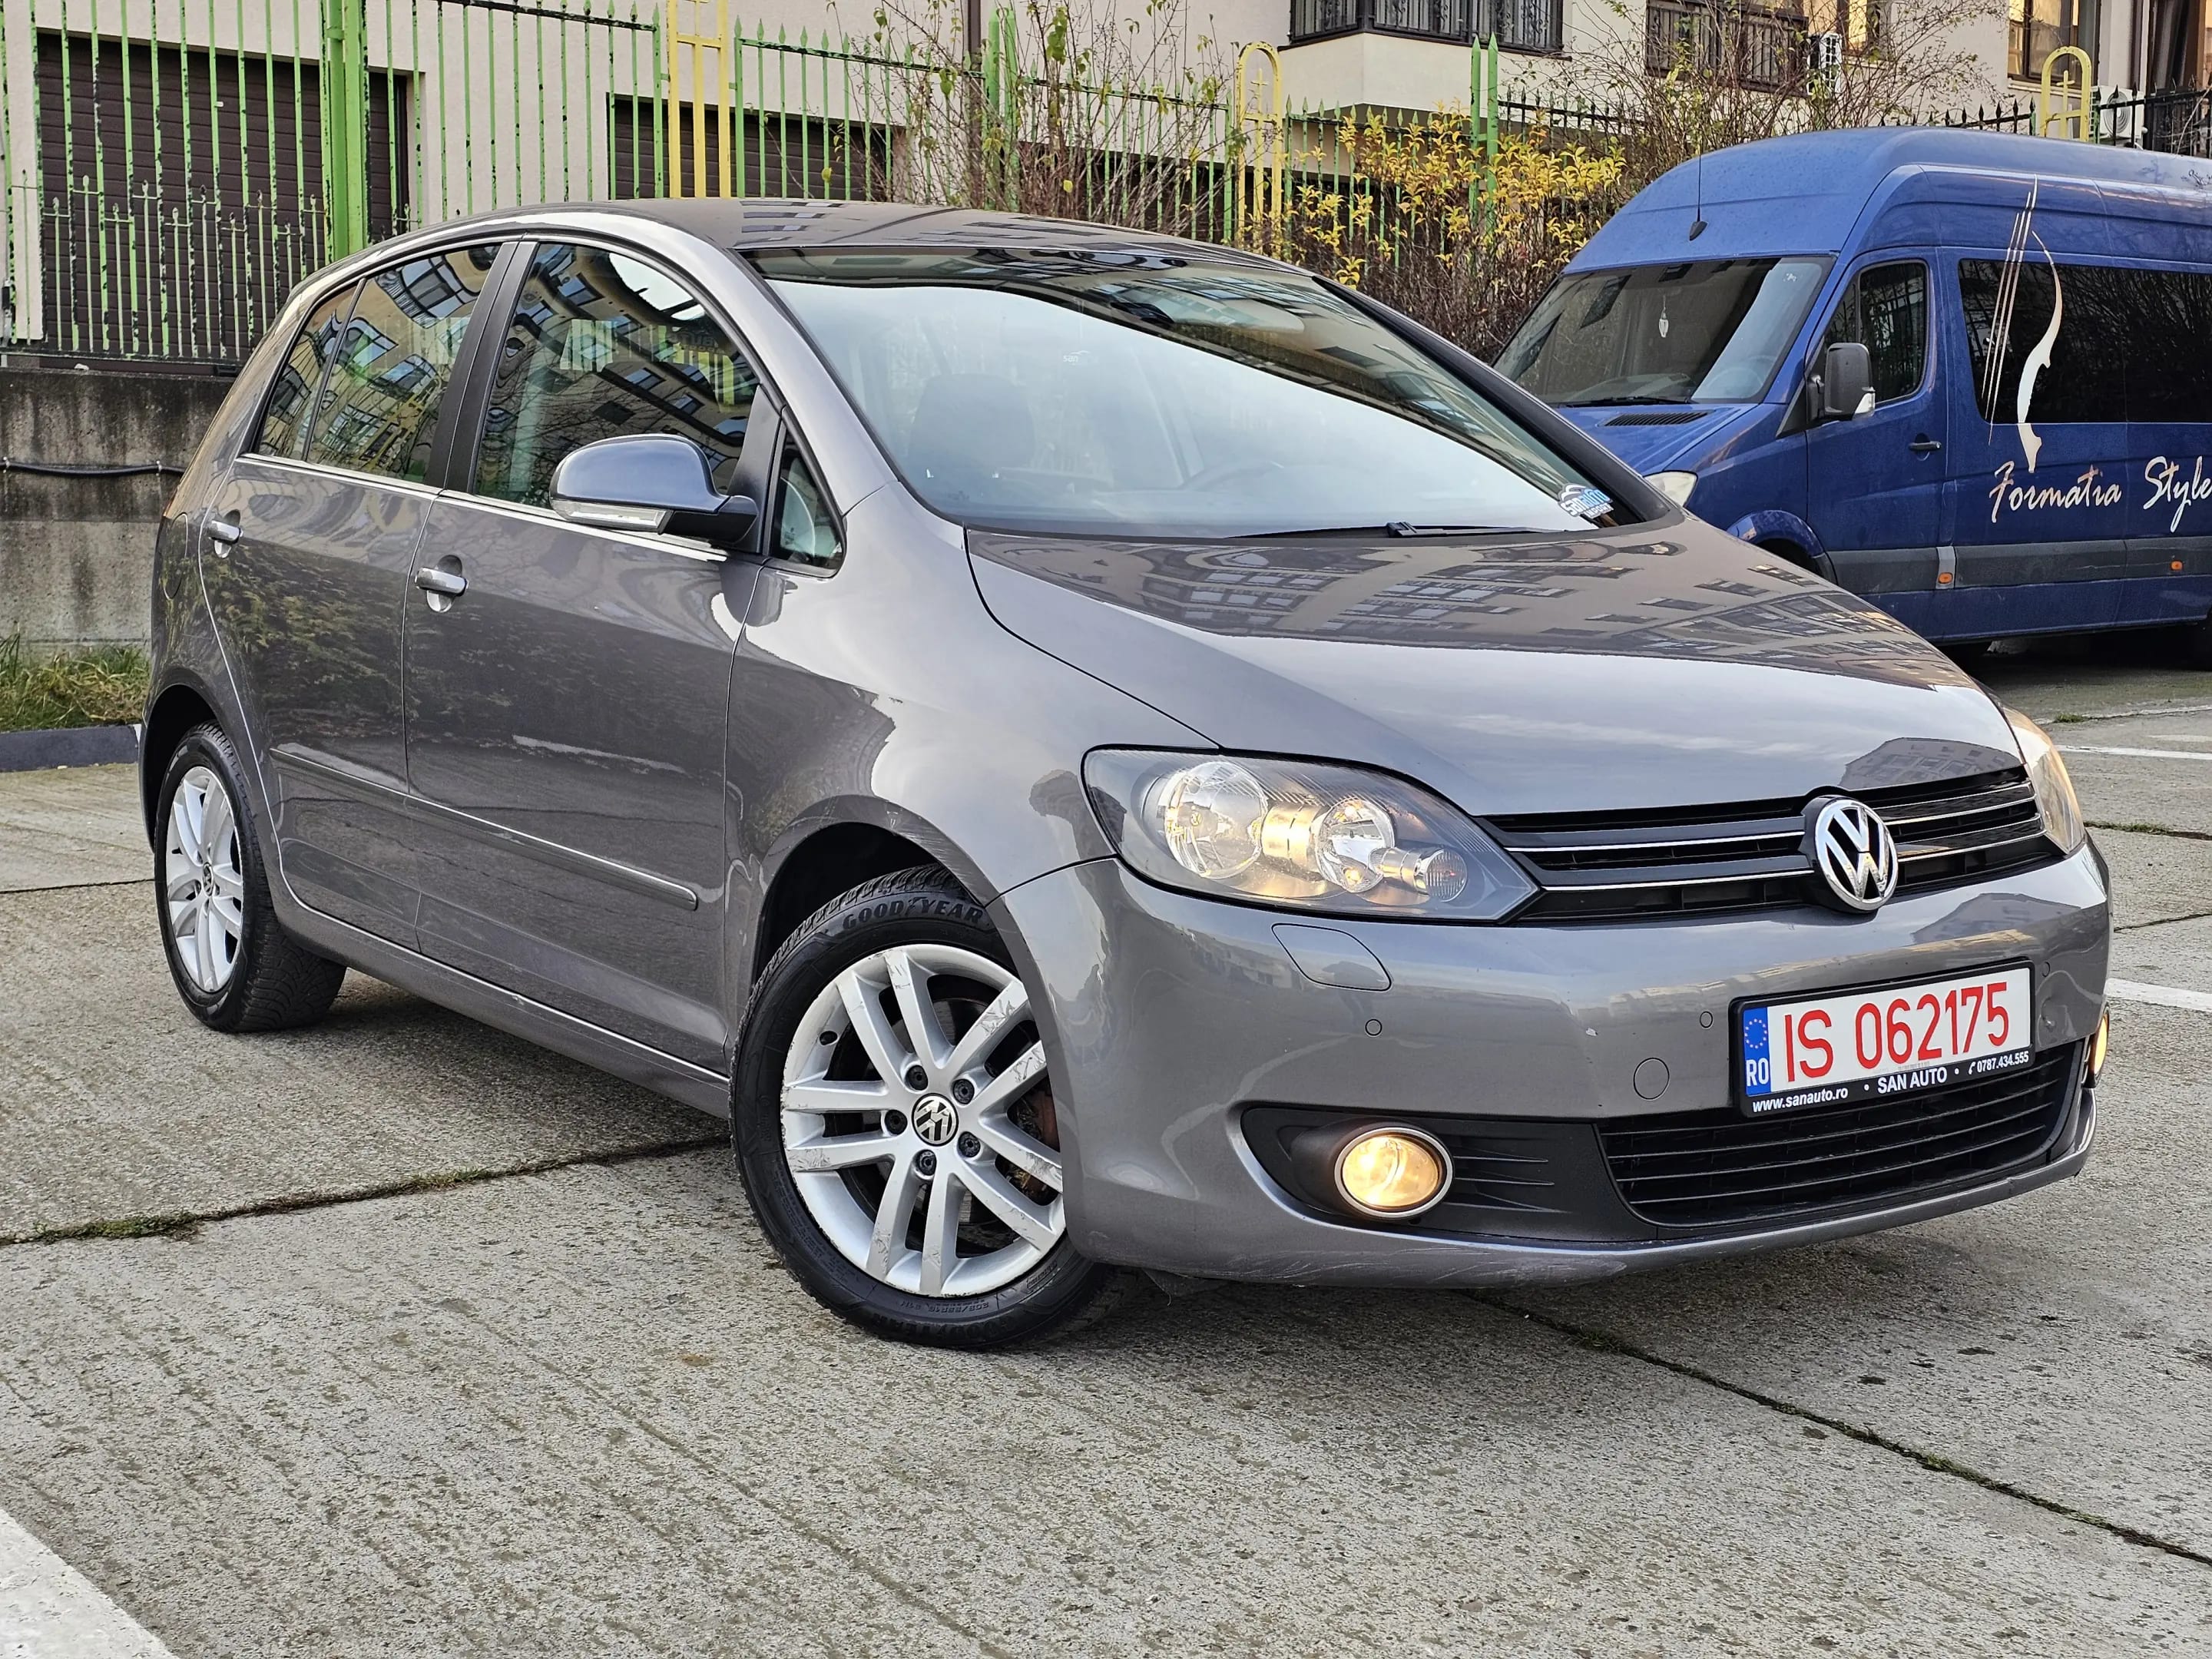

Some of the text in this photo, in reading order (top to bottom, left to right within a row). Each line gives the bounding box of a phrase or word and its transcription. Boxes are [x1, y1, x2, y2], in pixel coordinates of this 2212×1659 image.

[2144, 455, 2212, 532] Style
[1784, 981, 2009, 1082] IS 062175
[1746, 1058, 1769, 1087] RO
[1976, 1051, 2029, 1073] 0787.434.555
[1877, 1066, 1948, 1094] SAN AUTO
[1753, 1088, 1848, 1113] www.sanauto.ro
